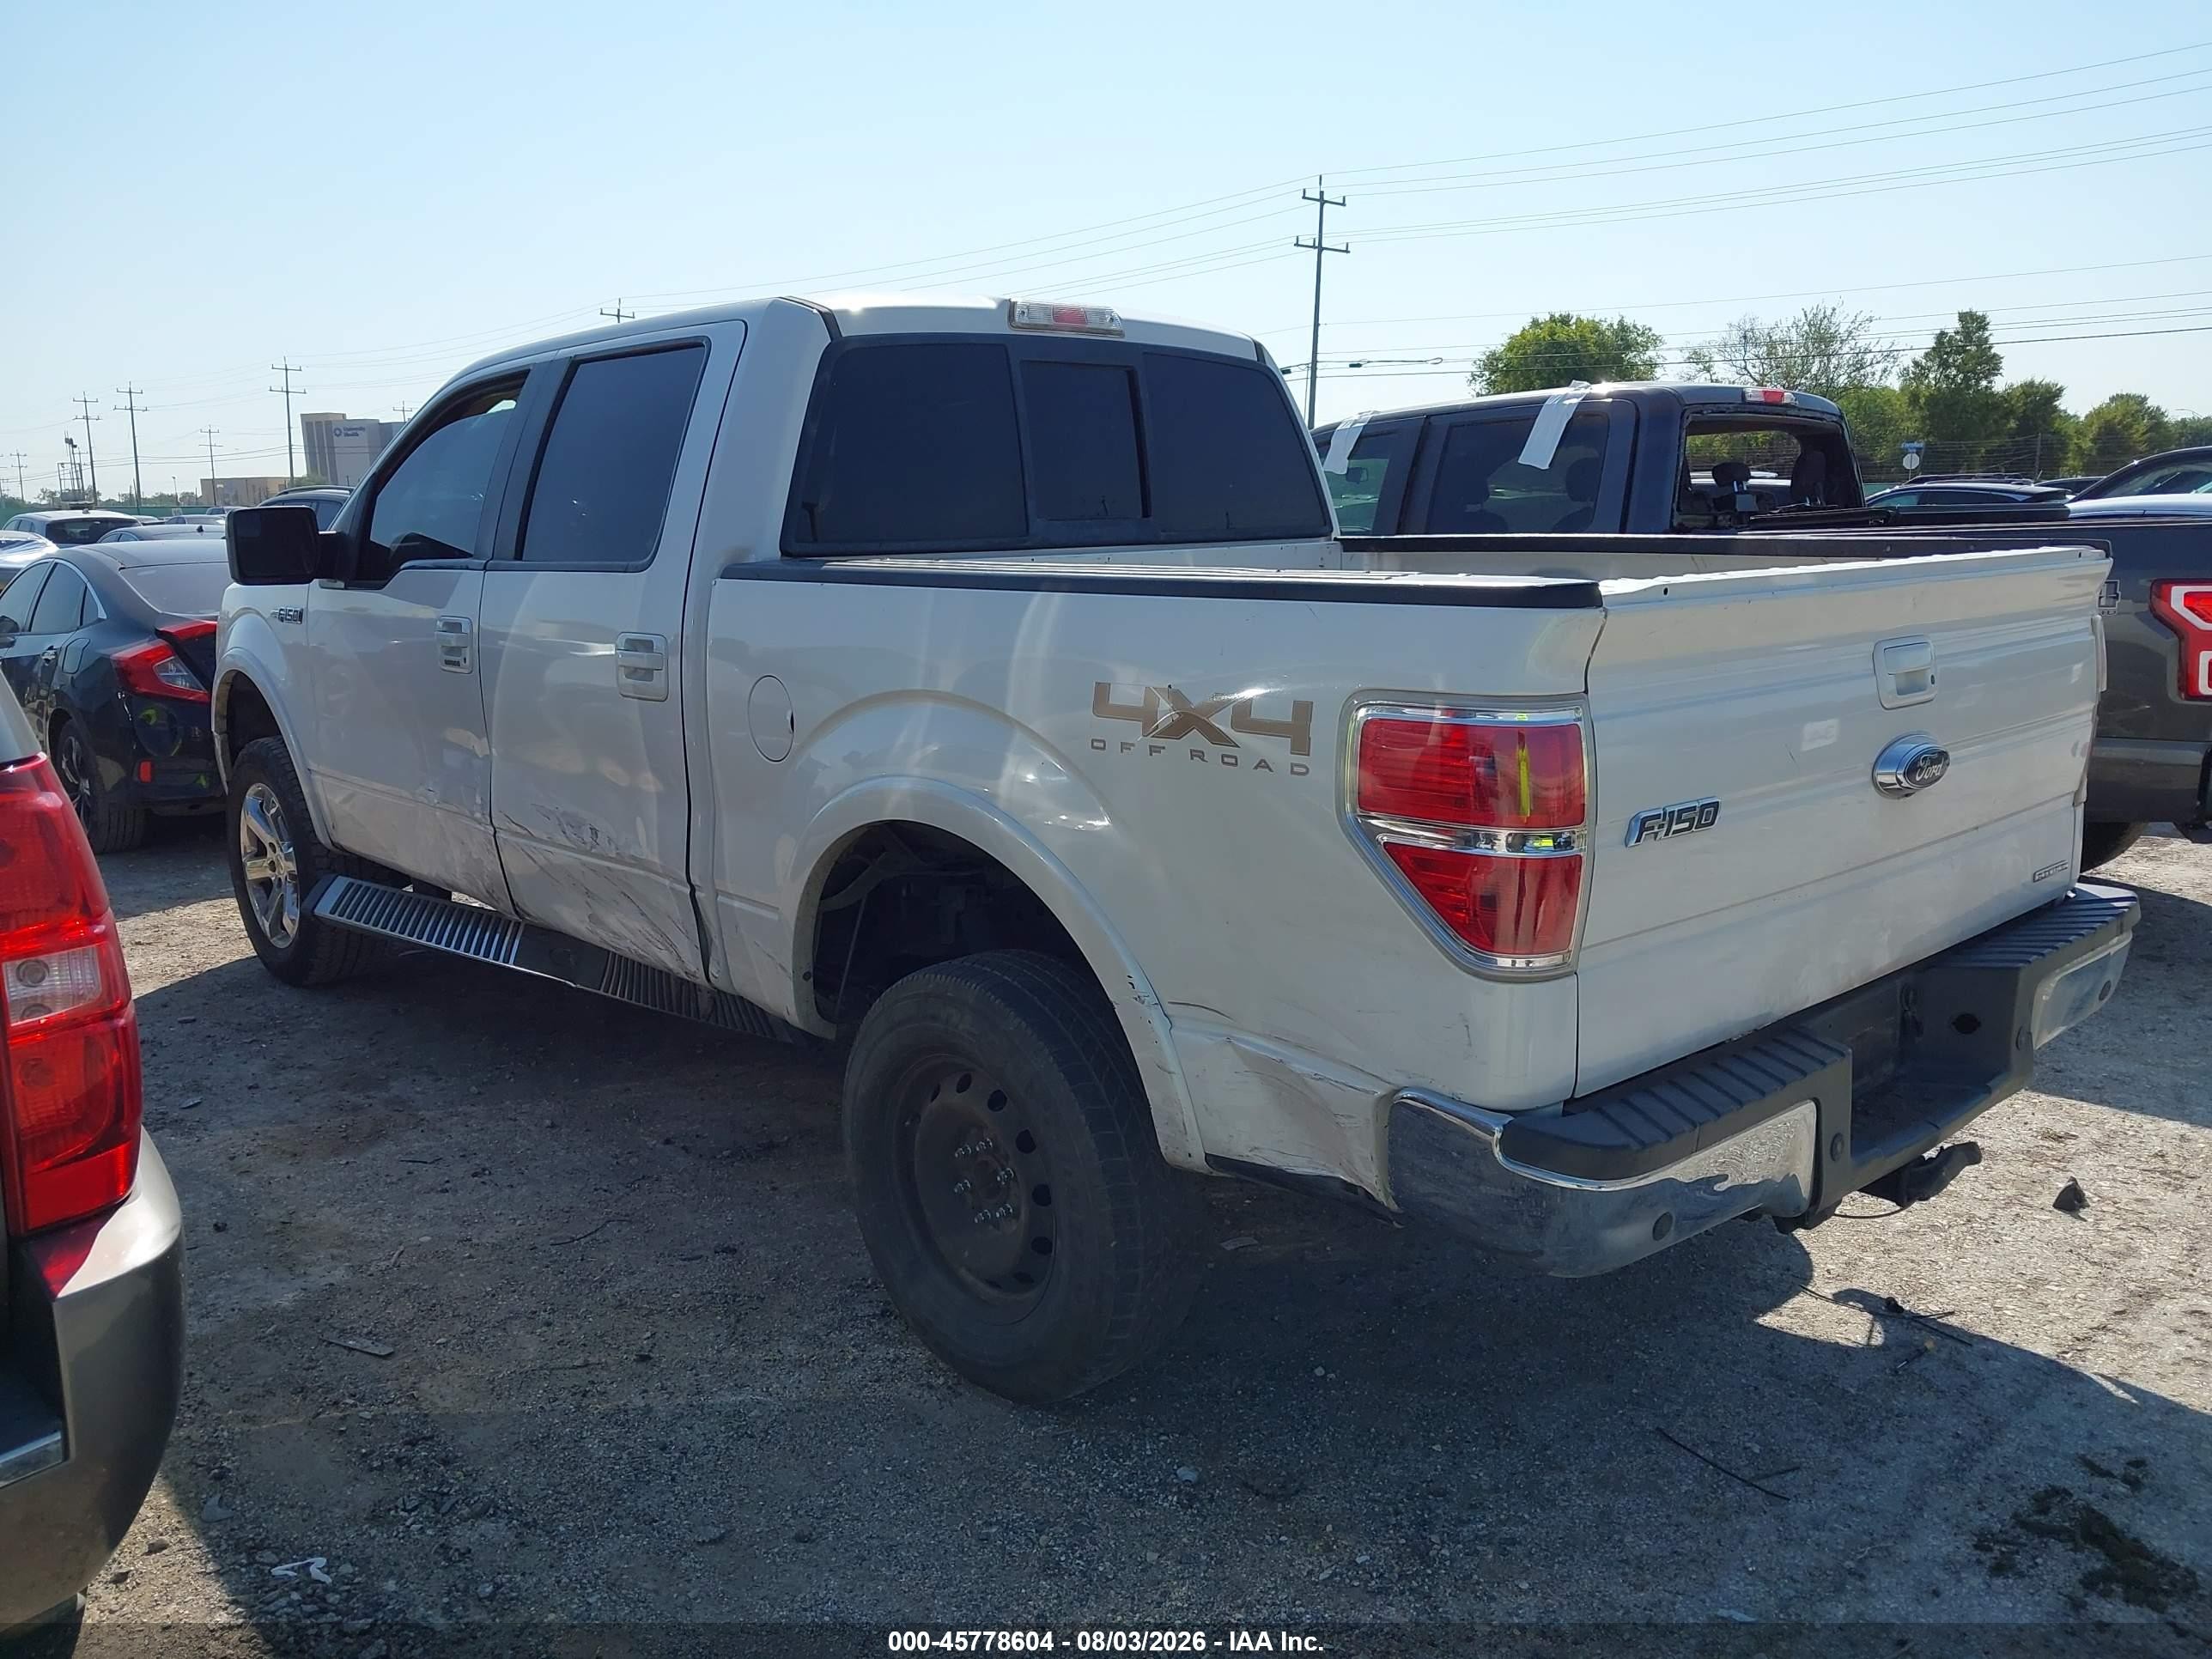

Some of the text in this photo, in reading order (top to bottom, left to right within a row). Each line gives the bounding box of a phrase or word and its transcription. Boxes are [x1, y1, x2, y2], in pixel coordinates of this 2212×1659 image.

[1189, 748, 1310, 776] ROAD
[1915, 754, 1945, 781] Ford
[1627, 798, 1721, 847] F-150
